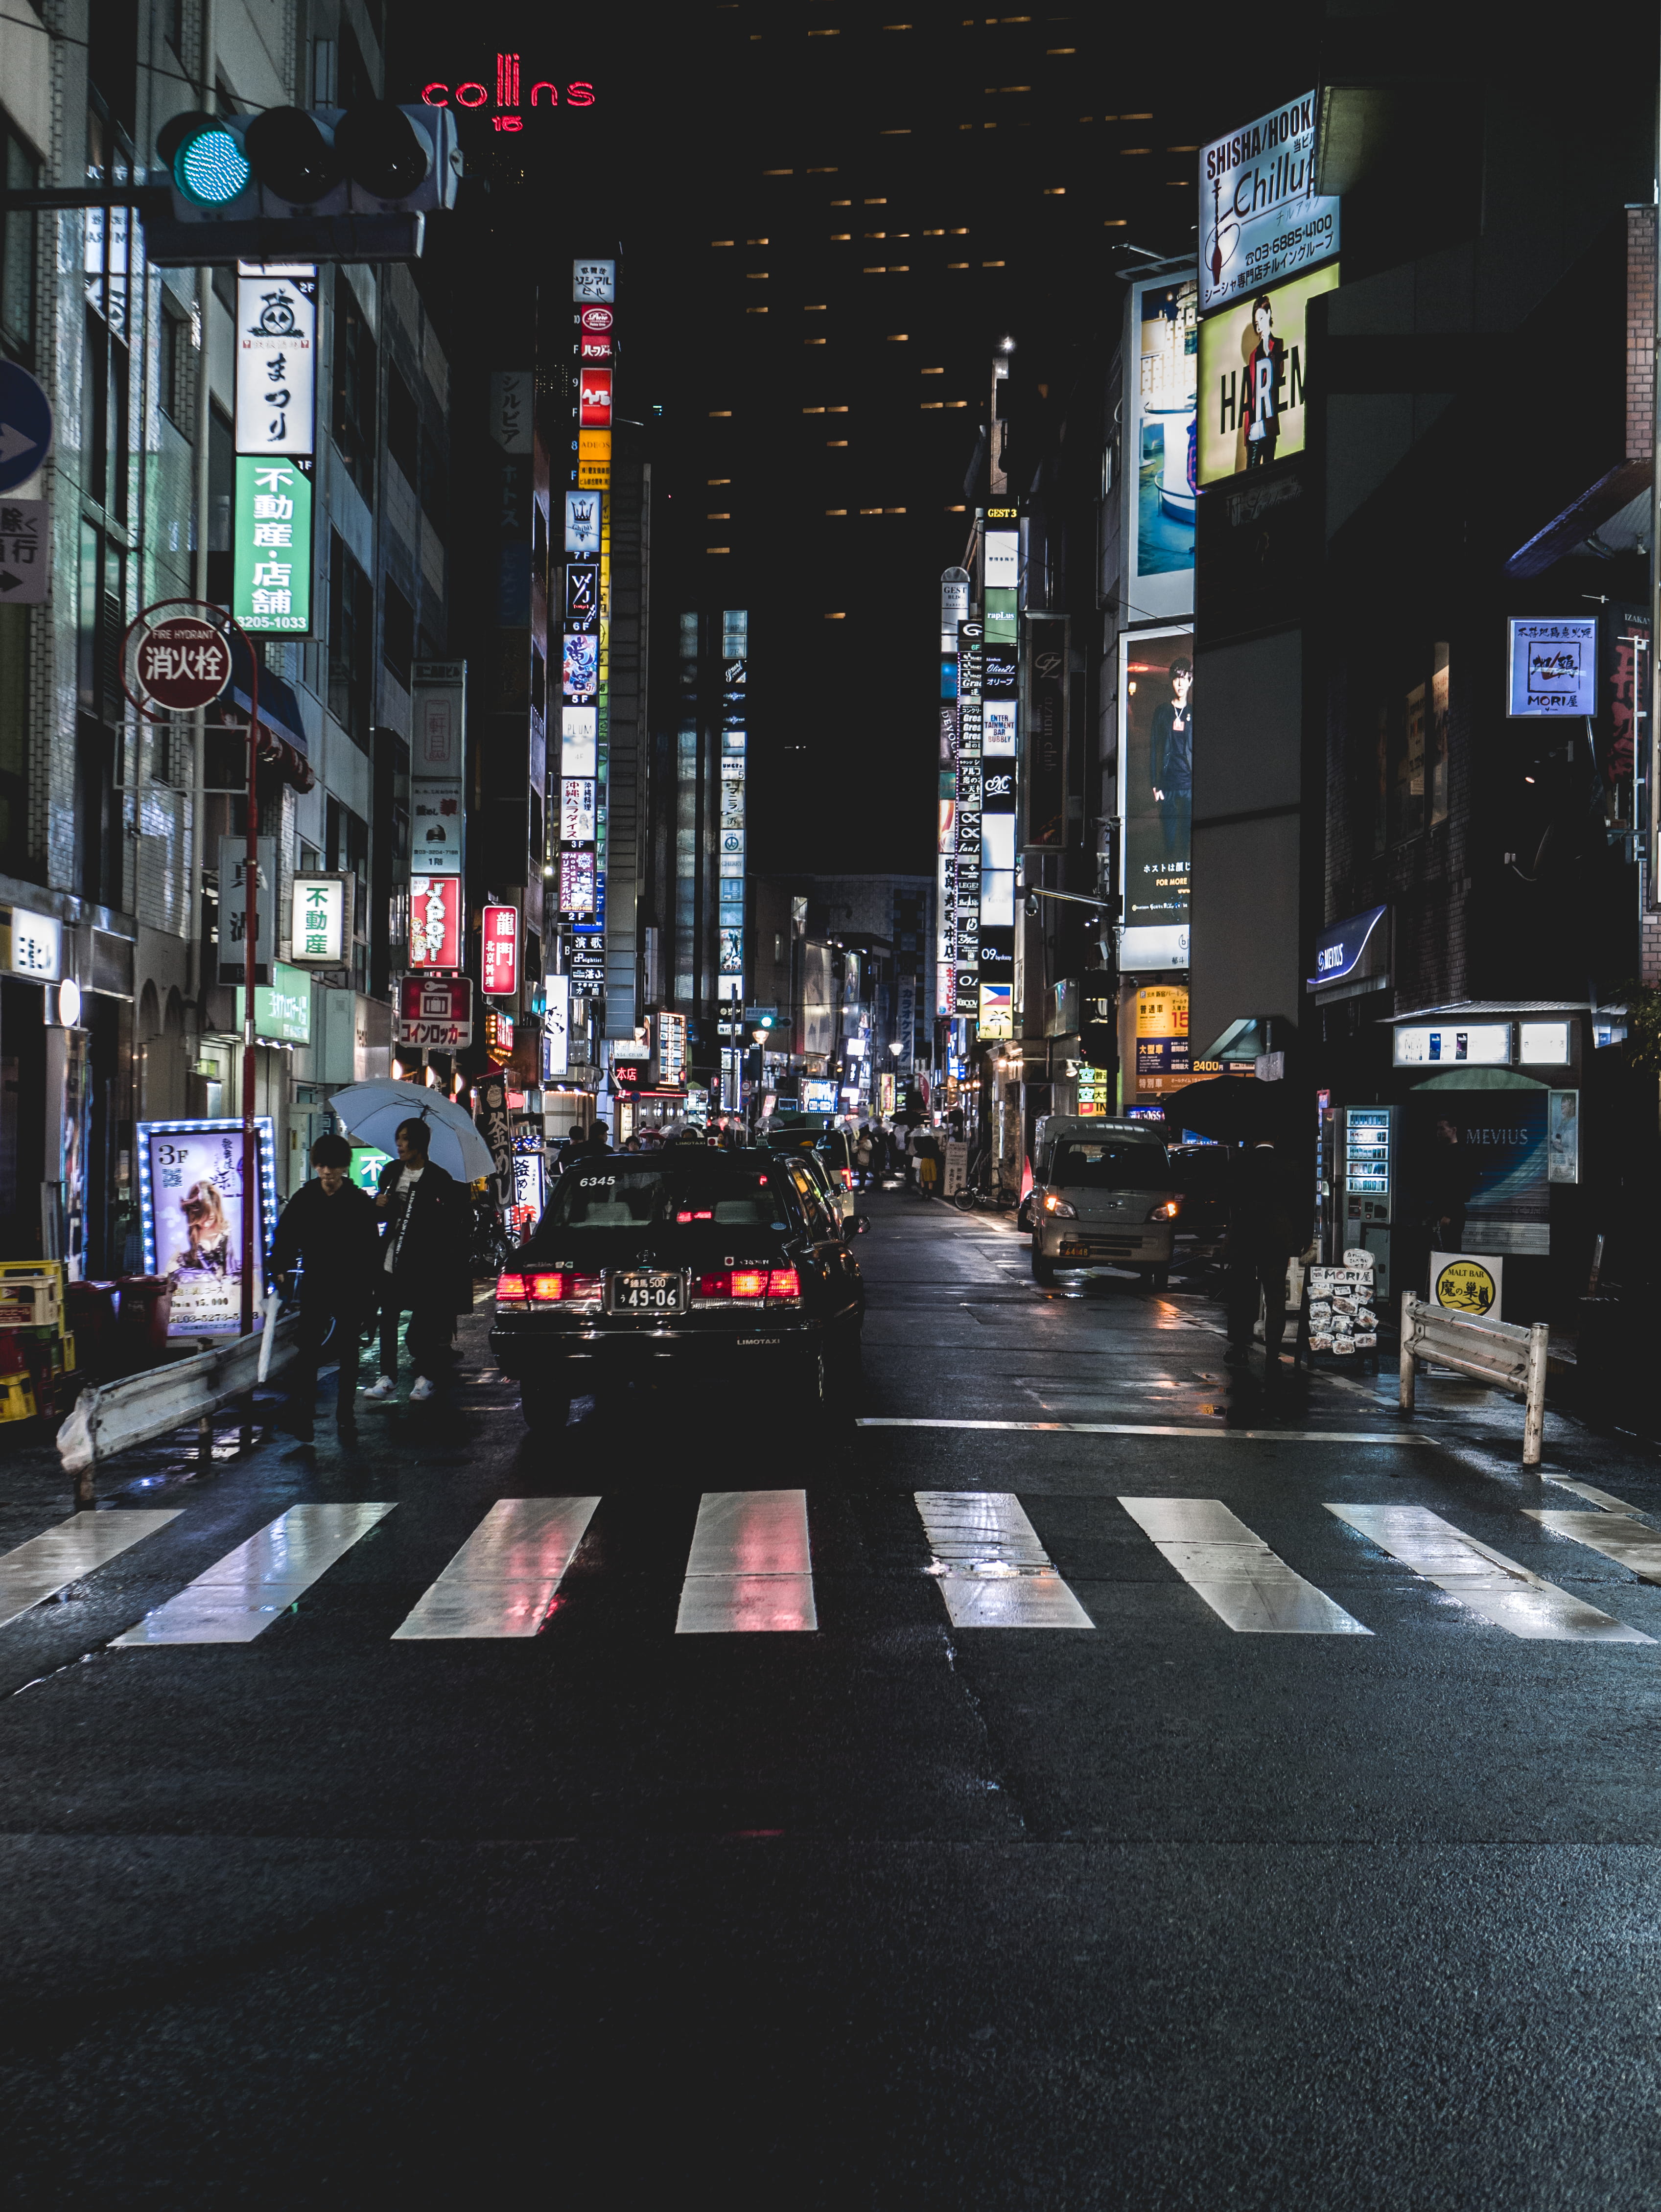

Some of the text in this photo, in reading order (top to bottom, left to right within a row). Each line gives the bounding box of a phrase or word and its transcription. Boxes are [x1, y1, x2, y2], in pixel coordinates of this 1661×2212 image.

[421, 52, 595, 107] collins
[1207, 98, 1314, 181] SHISHA/HOOK
[299, 282, 315, 293] 2F
[574, 315, 581, 324] 10
[573, 345, 579, 354] F
[572, 378, 579, 387] 9
[265, 353, 291, 442] まつり
[502, 376, 521, 444] シルビア
[572, 408, 578, 417] F
[571, 441, 578, 450] 8
[298, 461, 312, 470] 1F
[571, 470, 577, 480] F
[987, 509, 1010, 517] GEST
[252, 467, 294, 615] 不動産・店舗
[0, 538, 38, 564] 行
[237, 616, 307, 629] 3205-1033
[152, 629, 213, 640] FIRE HYDRANT
[145, 645, 223, 681] 消火栓
[738, 770, 744, 779] 5
[728, 787, 738, 810] マニラ
[1170, 877, 1188, 885] MORE
[305, 887, 329, 954] 不動産
[495, 912, 515, 966] 龍門
[565, 946, 570, 955] B
[981, 948, 996, 960] 09
[1324, 943, 1343, 970] MEVIUS
[485, 940, 495, 987] 北京料理
[1140, 1004, 1164, 1014] 普通車
[401, 1023, 468, 1045] コインロッカー
[1139, 1044, 1164, 1054] 大型車
[616, 1067, 637, 1081] 本店
[1078, 1067, 1095, 1083] 空
[1139, 1078, 1163, 1088] 特別車
[1078, 1086, 1095, 1103] 空
[1466, 1129, 1528, 1145] MEVIUS
[158, 1144, 188, 1165] 3F
[487, 1111, 511, 1205] 釜めし
[579, 1176, 616, 1187] 6345
[1448, 1268, 1467, 1277] MALT
[630, 1279, 666, 1288] 練馬 500
[1440, 1279, 1478, 1298] 魔の巣
[620, 1289, 677, 1306] う 49-06
